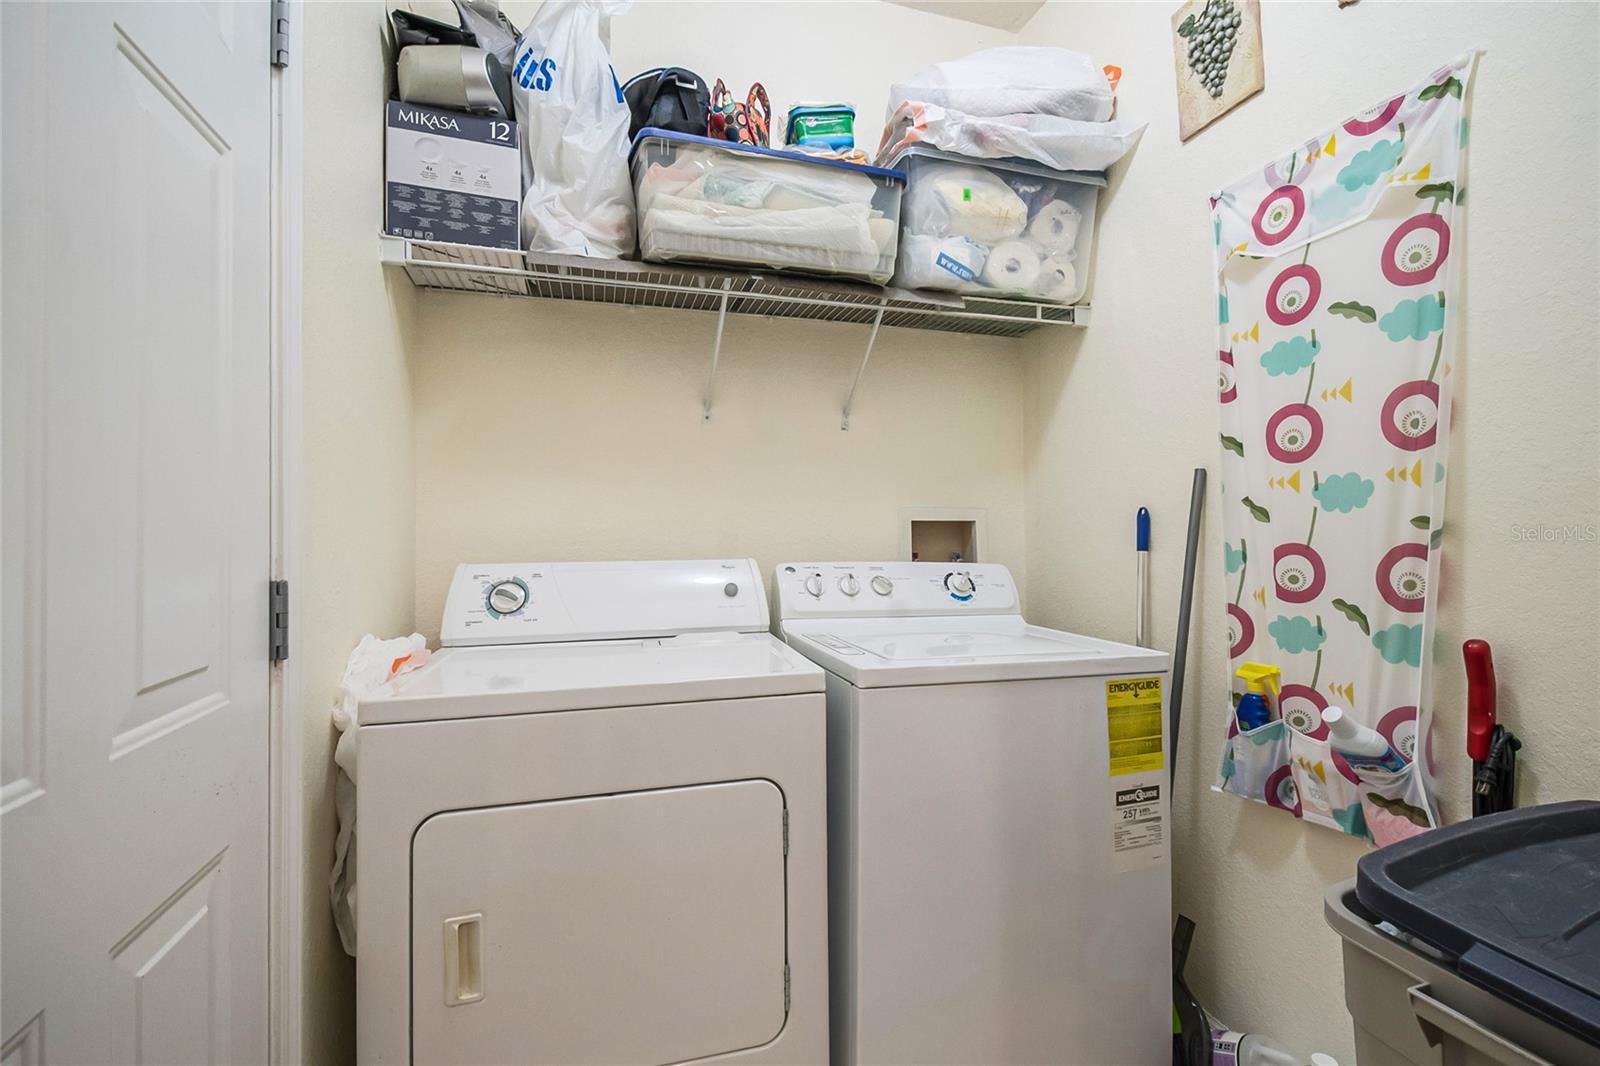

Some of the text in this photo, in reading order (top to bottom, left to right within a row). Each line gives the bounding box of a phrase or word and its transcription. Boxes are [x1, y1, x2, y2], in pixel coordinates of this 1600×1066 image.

[398, 108, 461, 132] MIKASA
[489, 120, 511, 141] 12
[1122, 808, 1137, 820] 257
